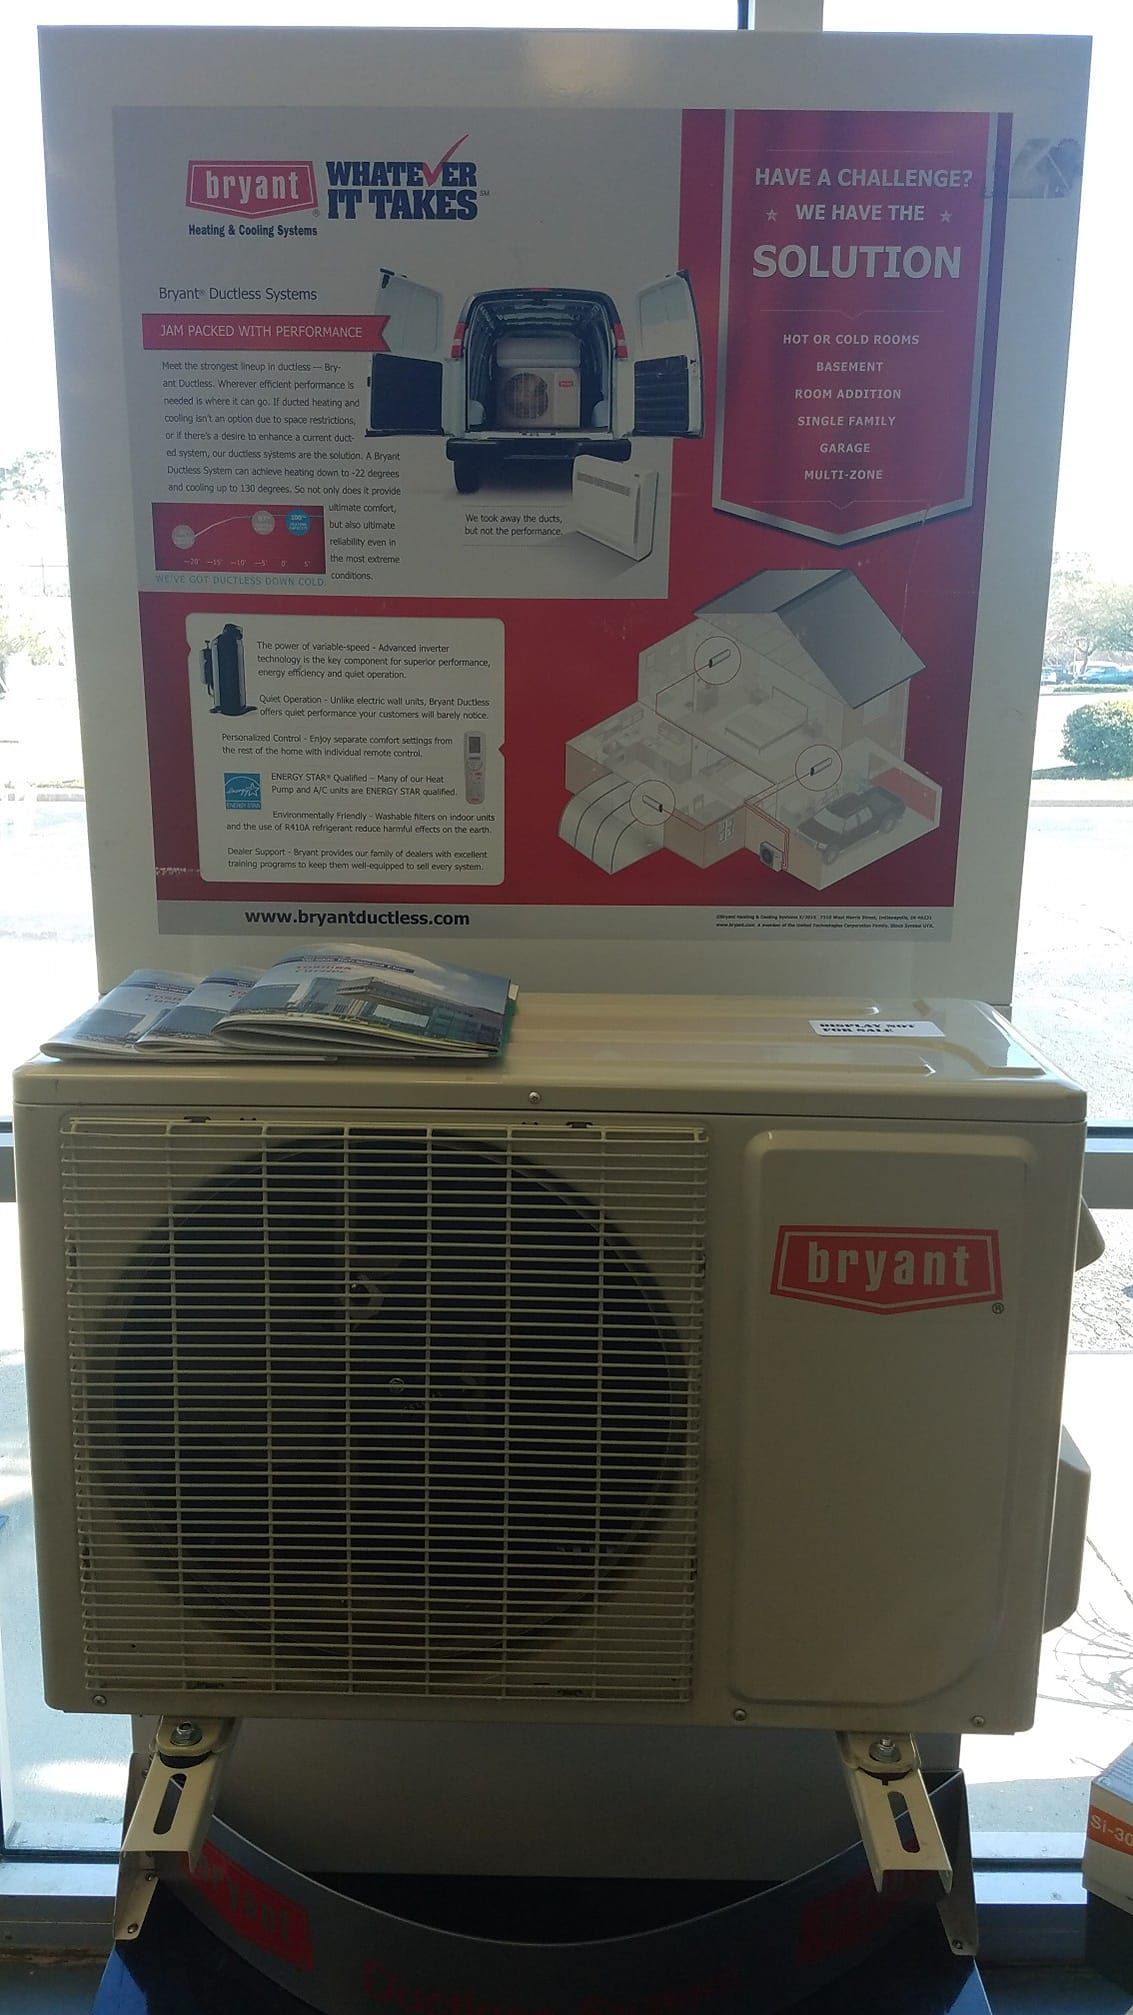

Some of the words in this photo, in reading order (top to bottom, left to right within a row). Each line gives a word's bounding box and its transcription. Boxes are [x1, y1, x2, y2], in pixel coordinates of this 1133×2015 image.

[326, 160, 477, 187] WHATEVER
[755, 167, 811, 185] HAVE
[816, 168, 831, 186] A
[837, 168, 972, 187] CHALLENGE?
[206, 169, 300, 204] bryant
[327, 189, 363, 220] IT
[369, 189, 478, 220] TAKES
[795, 204, 825, 220] WE
[831, 204, 882, 220] HAVE
[887, 205, 924, 220] THE
[188, 224, 225, 237] Heating
[227, 224, 235, 235] &
[238, 224, 274, 238] Cooling
[277, 224, 317, 238] Systems
[752, 244, 960, 278] SOLUTION
[209, 287, 261, 299] Ductless
[265, 287, 317, 301] Systems
[160, 324, 183, 336] JAM
[188, 324, 234, 336] PACKED
[238, 325, 271, 336] WITH
[275, 325, 362, 338] PERFORMANCE
[783, 334, 808, 344] HOT
[813, 334, 830, 344] OR
[835, 334, 869, 344] COLD
[873, 334, 919, 344] ROOMS
[816, 361, 883, 372] BASEMENT
[162, 379, 176, 387] ant
[178, 379, 214, 388] Ductless.
[217, 379, 256, 388] Wherever
[259, 379, 291, 388] efficient
[294, 380, 345, 389] performance
[347, 381, 354, 389] is
[794, 388, 831, 399] ROOM
[836, 388, 901, 399] ADDITION
[163, 396, 193, 405] needed
[196, 397, 203, 405] is
[232, 397, 238, 405] it
[257, 399, 270, 407] go.
[273, 397, 279, 406] If
[281, 397, 309, 406] ducted
[311, 398, 342, 408] heating
[344, 399, 359, 407] and
[797, 416, 843, 426] SINGLE
[848, 416, 895, 425] FAMILY
[819, 442, 870, 453] GARAGE
[167, 465, 201, 474] Ductless
[203, 466, 232, 476] System
[251, 467, 282, 476] achieve
[284, 468, 314, 478] heating
[316, 468, 338, 477] down
[340, 469, 349, 477] to
[367, 469, 399, 479] degrees
[804, 469, 882, 480] MULTI-ZONE
[168, 482, 183, 491] and
[185, 483, 214, 493] cooling
[216, 485, 227, 493] up
[229, 484, 238, 492] to
[240, 483, 255, 492] 130
[257, 485, 292, 495] degrees.
[294, 485, 305, 494] So
[307, 485, 320, 494] not
[322, 485, 339, 496] only
[342, 486, 361, 494] does
[363, 486, 369, 495] it
[371, 487, 401, 496] provide
[328, 503, 361, 512] ultimate
[363, 503, 396, 513] comfort,
[465, 514, 478, 522] We
[480, 513, 498, 522] took
[500, 515, 520, 523] away
[523, 514, 536, 522] the
[538, 515, 562, 523] ducts,
[329, 520, 342, 528] but
[344, 520, 361, 529] also
[363, 521, 395, 529] ultimate
[464, 526, 478, 535] but
[480, 527, 493, 535] not
[495, 526, 509, 535] the
[510, 527, 563, 536] performance.
[329, 537, 365, 547] reliability
[388, 538, 396, 546] in
[330, 553, 343, 562] the
[345, 555, 365, 563] most
[367, 555, 400, 563] extreme
[188, 575, 208, 584] GOT
[212, 575, 261, 585] DUCTLESS
[265, 576, 294, 585] DOWN
[298, 577, 325, 586] COLD
[330, 572, 373, 580] conditions.
[257, 654, 301, 665] technology
[303, 655, 310, 663] is
[311, 655, 325, 664] the
[327, 656, 341, 665] key
[343, 657, 388, 665] component
[390, 657, 401, 665] for
[438, 658, 490, 667] performance,
[259, 707, 282, 716] offers
[284, 708, 305, 718] quiet
[307, 709, 357, 717] performance
[358, 711, 376, 719] your
[378, 710, 419, 718] customers
[421, 710, 434, 718] will
[436, 711, 460, 720] barely
[462, 711, 488, 719] notice.
[222, 745, 235, 754] the
[255, 746, 263, 754] of
[280, 747, 303, 755] home
[304, 747, 322, 755] with
[324, 747, 361, 756] individual
[363, 749, 391, 757] remote
[393, 749, 422, 757] control.
[271, 785, 294, 794] Pump
[296, 786, 310, 794] and
[313, 786, 327, 794] A/C
[365, 787, 398, 795] ENERGY
[399, 787, 420, 795] STAR
[422, 787, 457, 796] qualified.
[228, 860, 257, 869] training
[259, 861, 296, 869] programs
[308, 861, 327, 869] keep
[329, 861, 349, 869] them
[351, 862, 404, 871] well-equipped
[431, 863, 452, 871] every
[454, 863, 483, 871] system.
[245, 909, 469, 925] www.bryantductless.com
[807, 1241, 969, 1292] bryant
